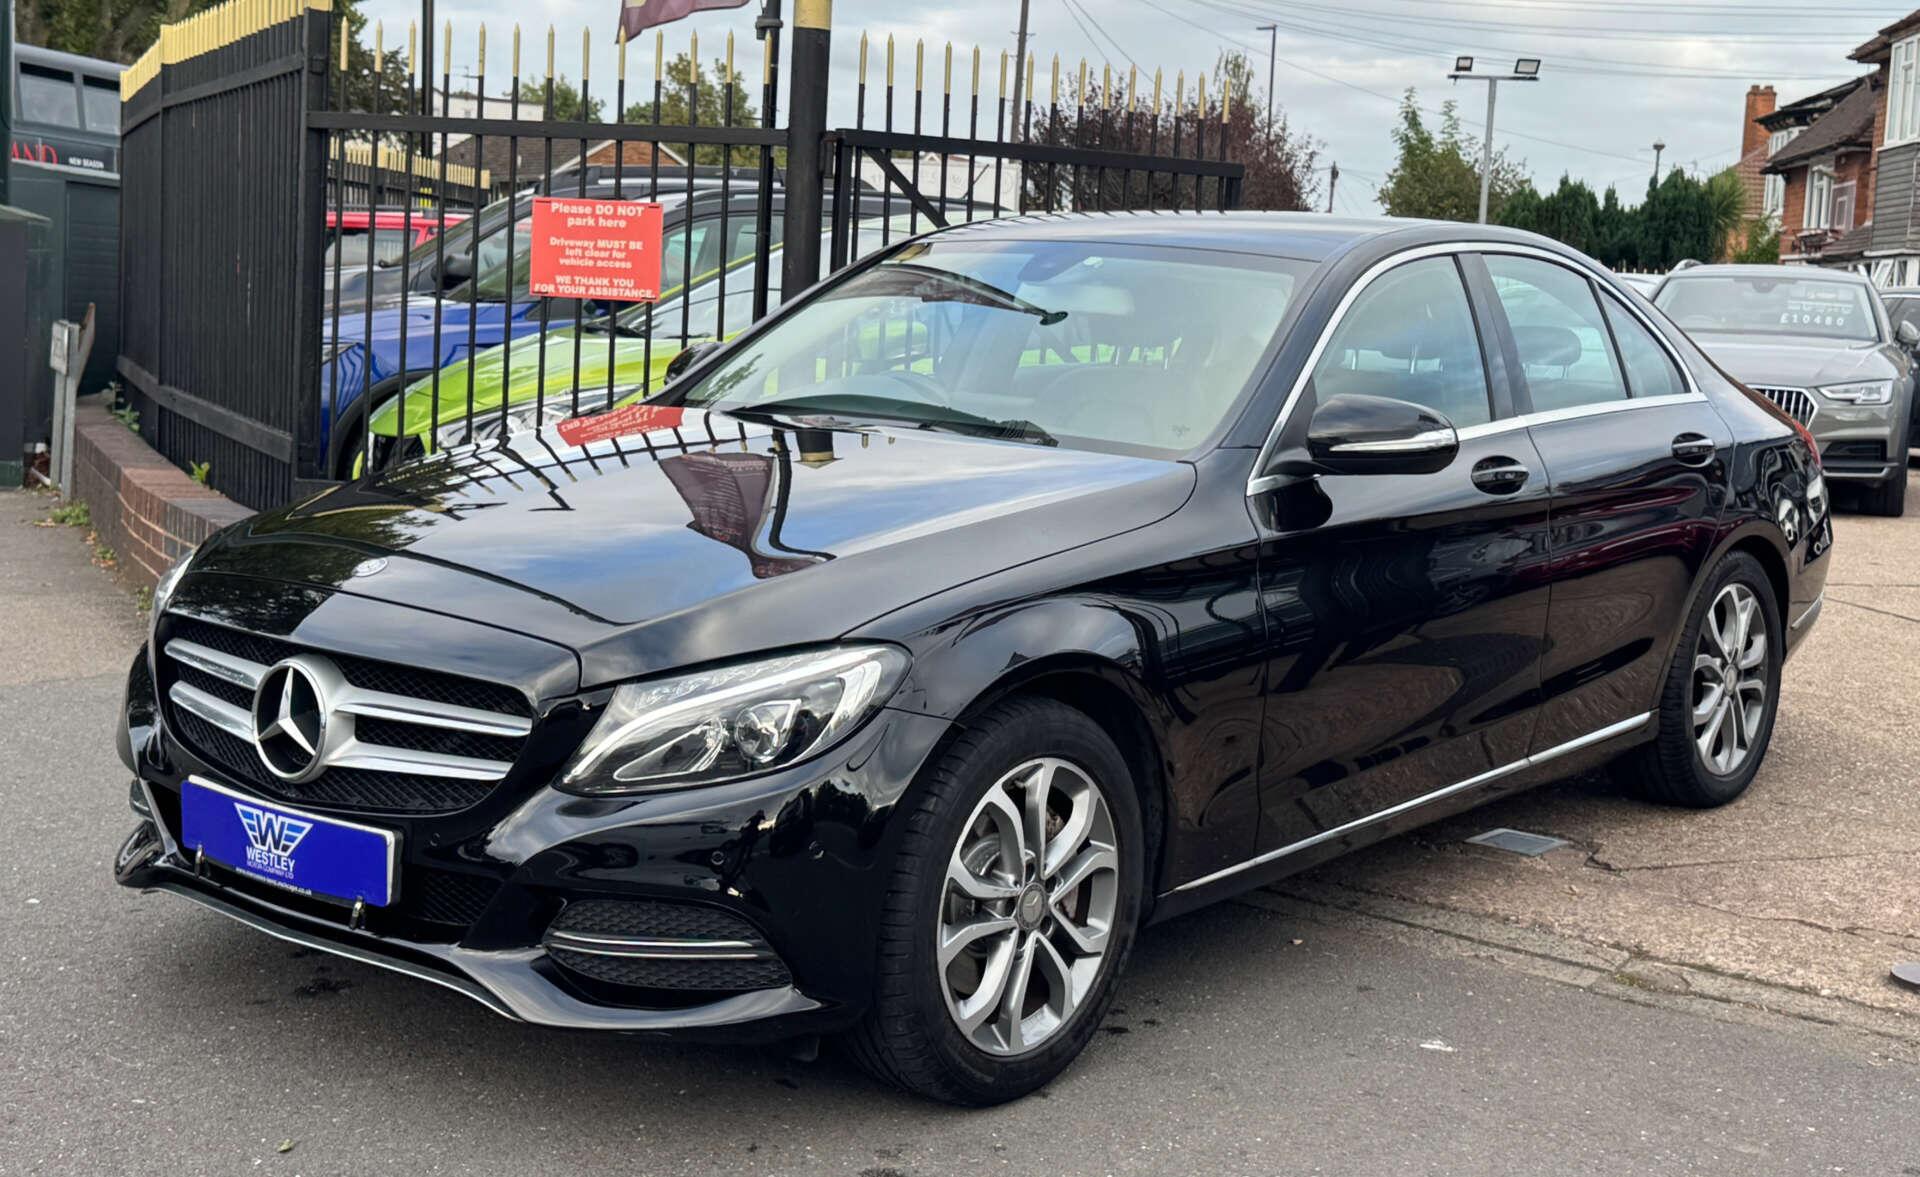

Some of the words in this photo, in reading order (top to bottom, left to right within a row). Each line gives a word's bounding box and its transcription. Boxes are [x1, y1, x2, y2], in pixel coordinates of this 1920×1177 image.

[68, 157, 82, 166] NEW
[83, 158, 104, 169] SEASON
[551, 202, 593, 215] Please
[595, 204, 614, 216] DO
[617, 205, 645, 217] NOT
[567, 216, 596, 228] park
[598, 218, 627, 229] here
[549, 236, 595, 249] Driveway
[596, 239, 627, 250] MUST
[628, 240, 644, 250] BE
[565, 248, 583, 258] left
[585, 248, 609, 258] clear
[612, 249, 627, 259] for
[559, 257, 594, 267] vehicle
[596, 259, 632, 269] access
[554, 275, 572, 285] WE
[574, 276, 610, 287] THANK
[612, 278, 635, 288] YOU
[534, 283, 555, 293] FOR
[557, 285, 586, 295] YOUR
[588, 287, 656, 299] ASSISTANCE.
[1780, 313, 1844, 327] £10480
[246, 844, 295, 872] WESTLEY
